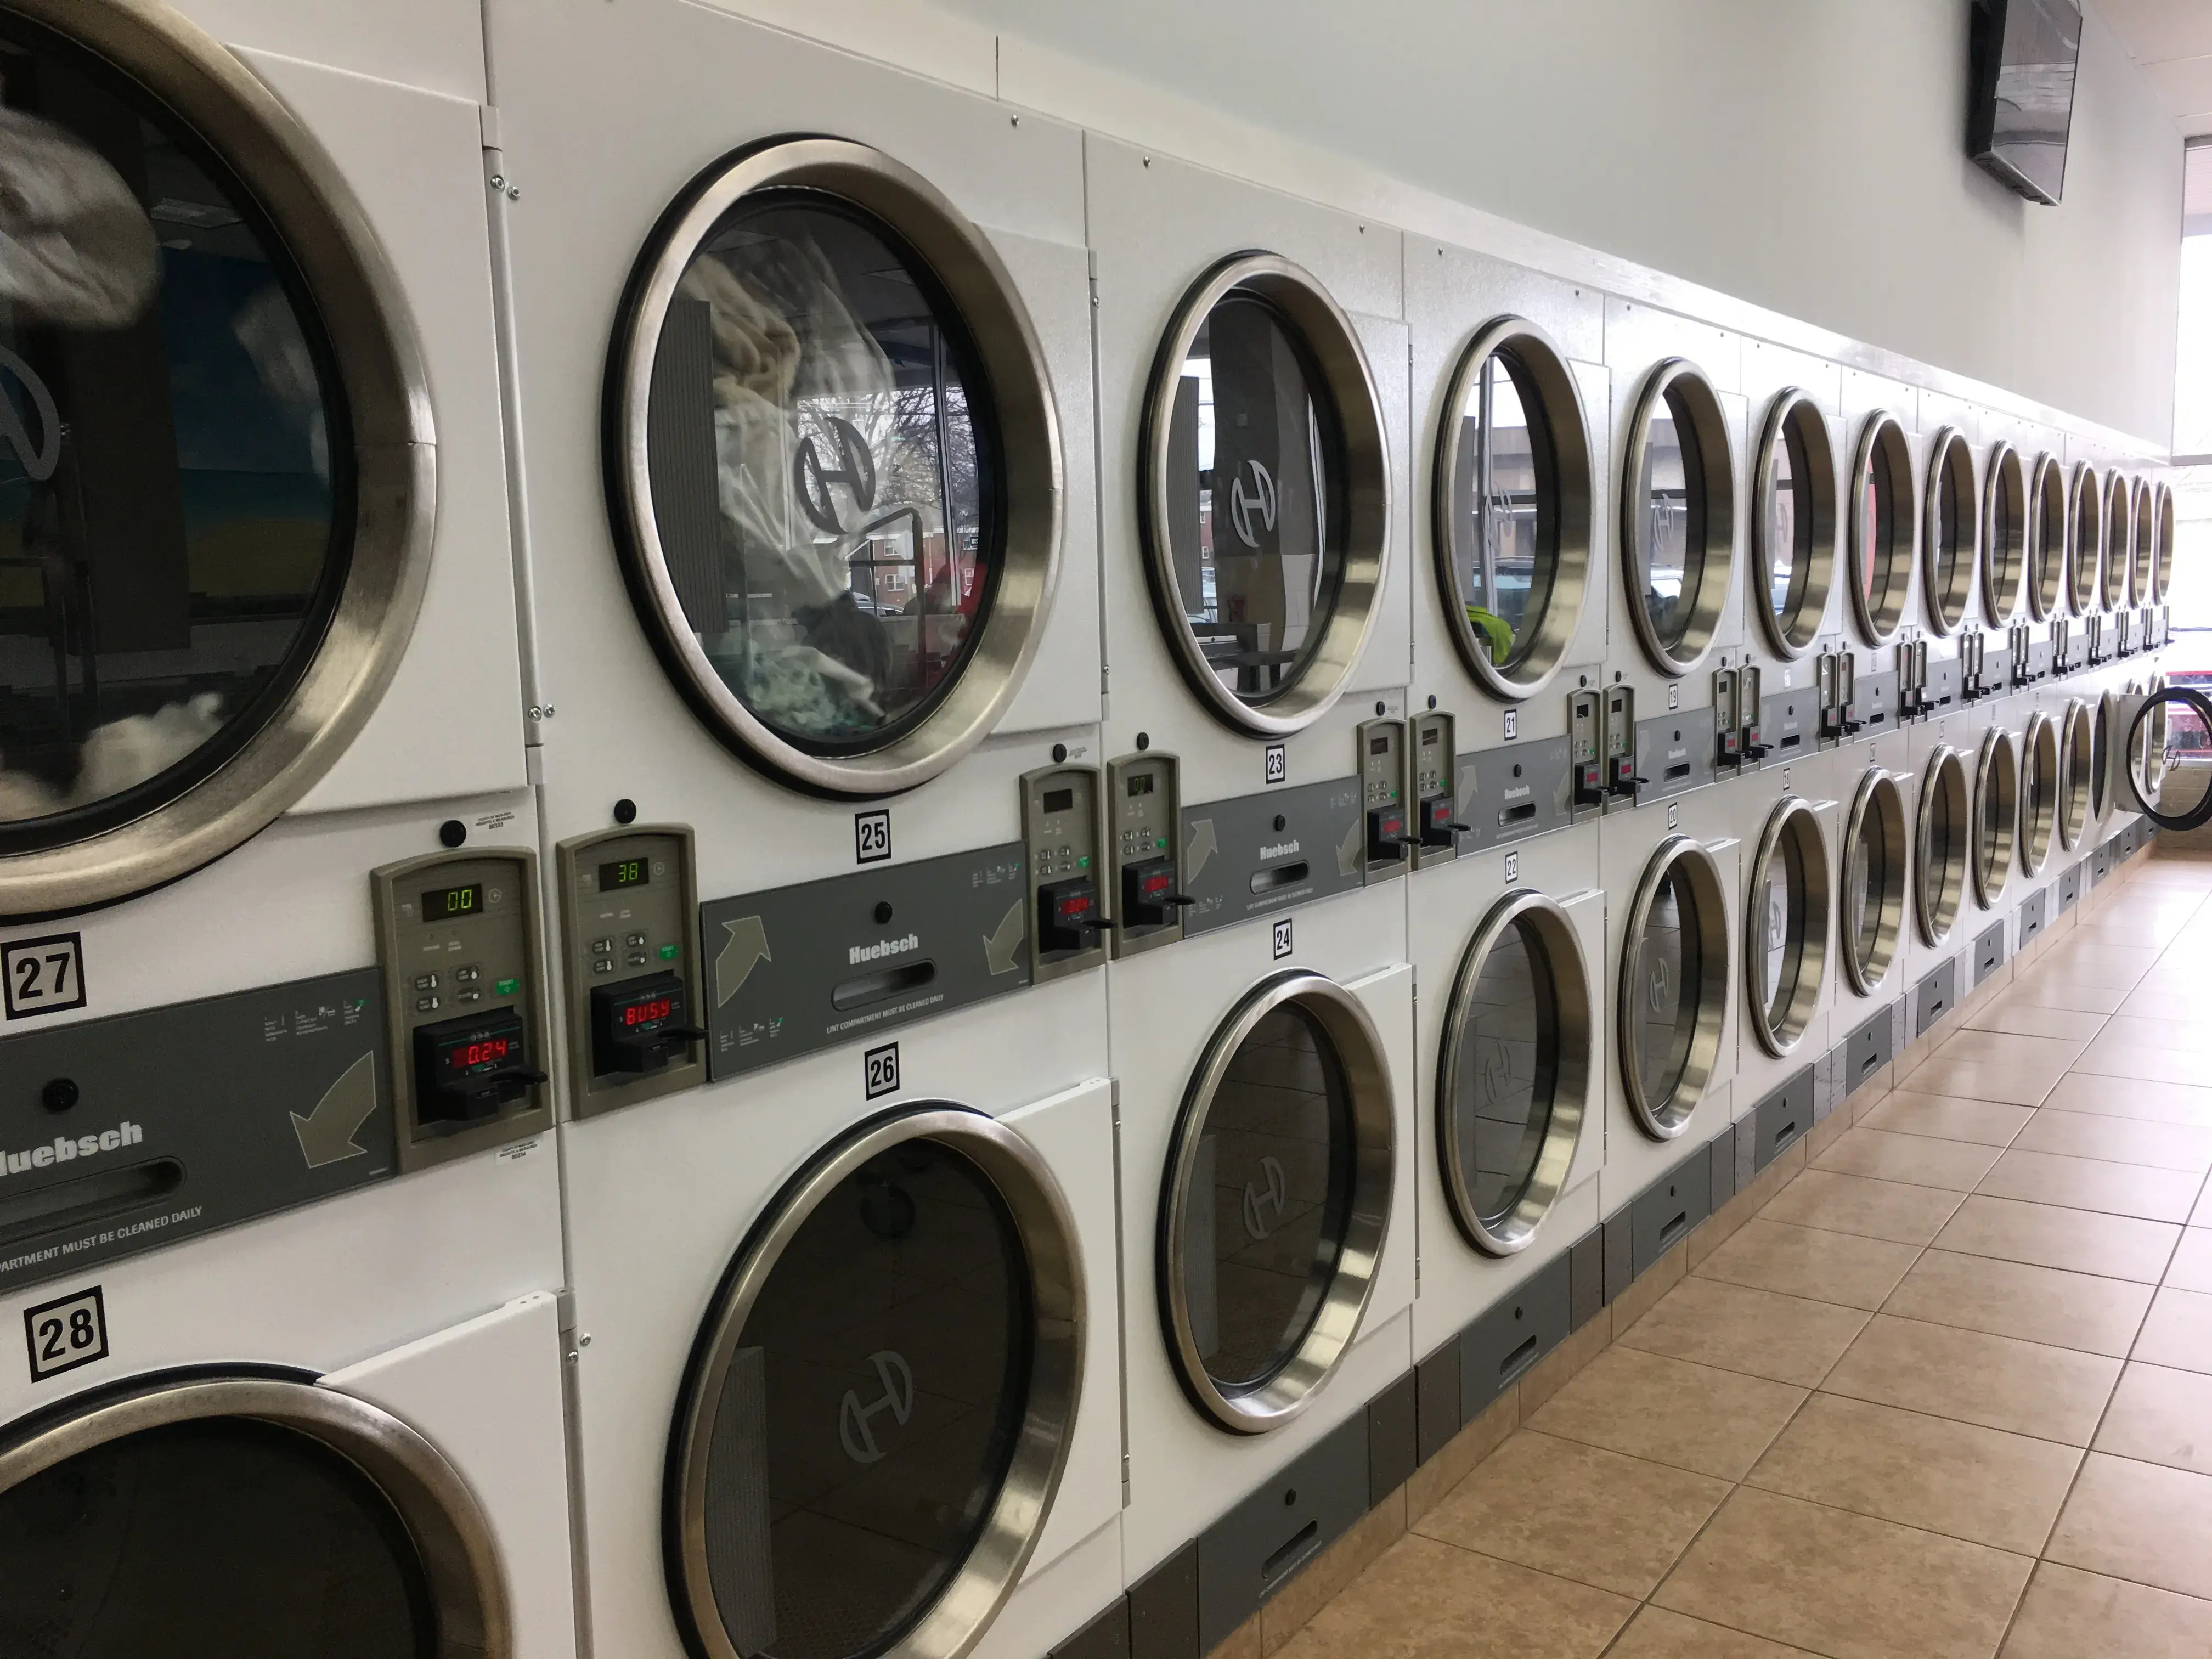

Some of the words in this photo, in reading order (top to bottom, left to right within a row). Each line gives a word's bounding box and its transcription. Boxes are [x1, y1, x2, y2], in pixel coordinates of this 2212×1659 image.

[1670, 690, 1676, 703] 19
[1506, 716, 1516, 733] 21
[1269, 753, 1282, 775] 23
[1669, 808, 1676, 823] 20
[861, 822, 885, 851] 25
[1260, 839, 1299, 860] Huebsch
[618, 862, 638, 882] 38
[1507, 859, 1516, 876] 22
[447, 889, 472, 911] 00
[849, 933, 918, 965] Huebsch
[1276, 928, 1290, 951] 24
[15, 952, 71, 1000] 27
[627, 1000, 669, 1025] BUSY
[827, 1024, 839, 1034] LINT
[840, 1012, 882, 1030] COMPARTMENT
[883, 1007, 898, 1017] MUST
[899, 1005, 905, 1013] BE
[906, 998, 929, 1011] CLEANED
[930, 994, 944, 1003] DAILY
[870, 1056, 894, 1087] 26
[63, 1235, 98, 1255] MUST
[99, 1232, 115, 1244] BE
[117, 1216, 169, 1238] CLEANED
[171, 1206, 202, 1223] DAILY
[40, 1308, 94, 1361] 28
